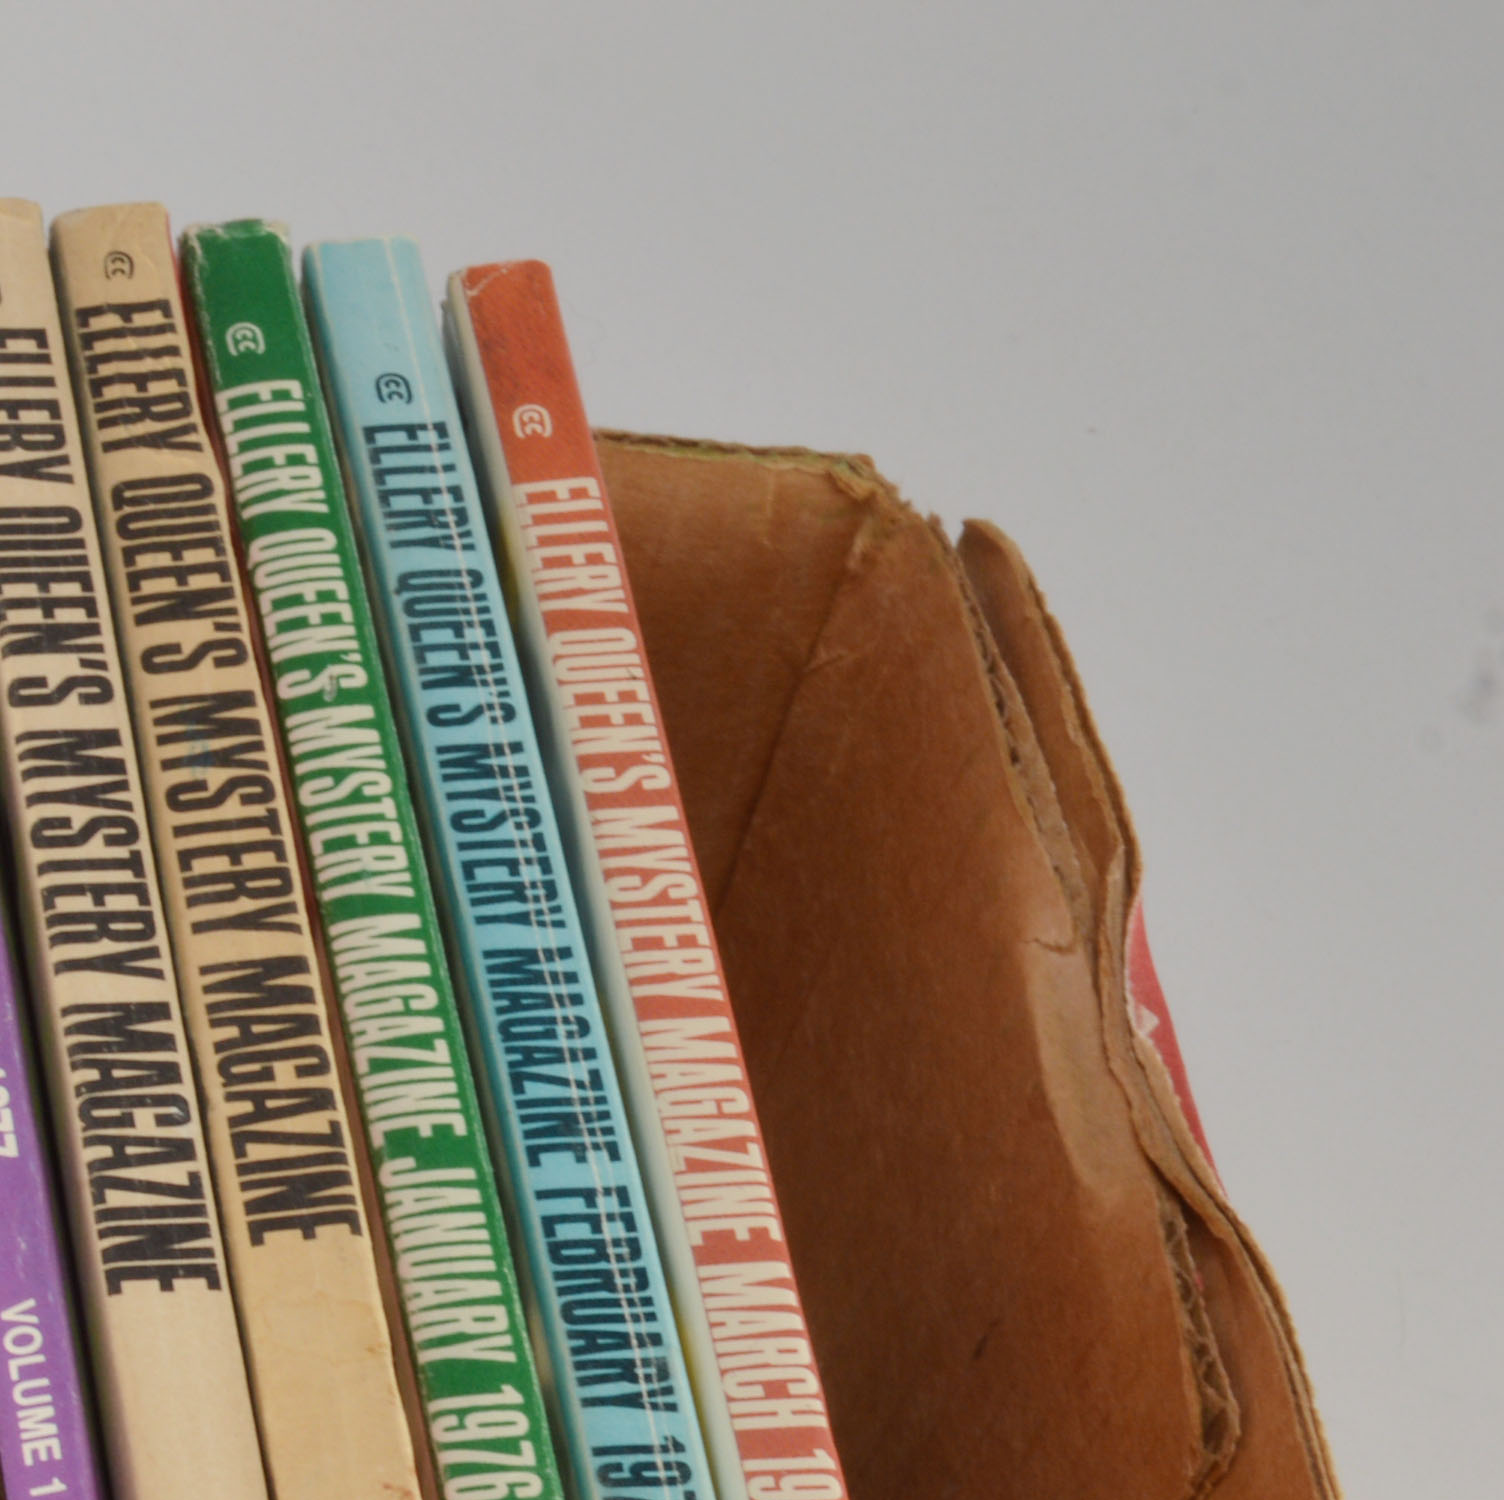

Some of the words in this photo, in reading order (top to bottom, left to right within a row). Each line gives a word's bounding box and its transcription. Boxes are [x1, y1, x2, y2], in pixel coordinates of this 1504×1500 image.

[69, 299, 200, 452] ELLERY
[216, 379, 327, 516] ELLERY
[111, 474, 246, 673] QUEEN'S
[249, 528, 366, 698] QUEEN'S
[511, 477, 626, 613] ELLERY
[288, 704, 412, 898] MYSTERY
[544, 627, 670, 786] QUEEN'S
[18, 728, 161, 977] MYSTERY
[151, 691, 298, 932] MYSTERY
[587, 805, 722, 1004] MYSTERY
[202, 956, 358, 1243] MAGAZINE
[332, 914, 465, 1143] MAGAZINE
[64, 1002, 218, 1292] MAGAZINE
[637, 1016, 780, 1244] MAGAZINE
[381, 1158, 513, 1361] JANUARY
[694, 1260, 827, 1438] MARCH
[1, 1299, 60, 1465] VOLUME
